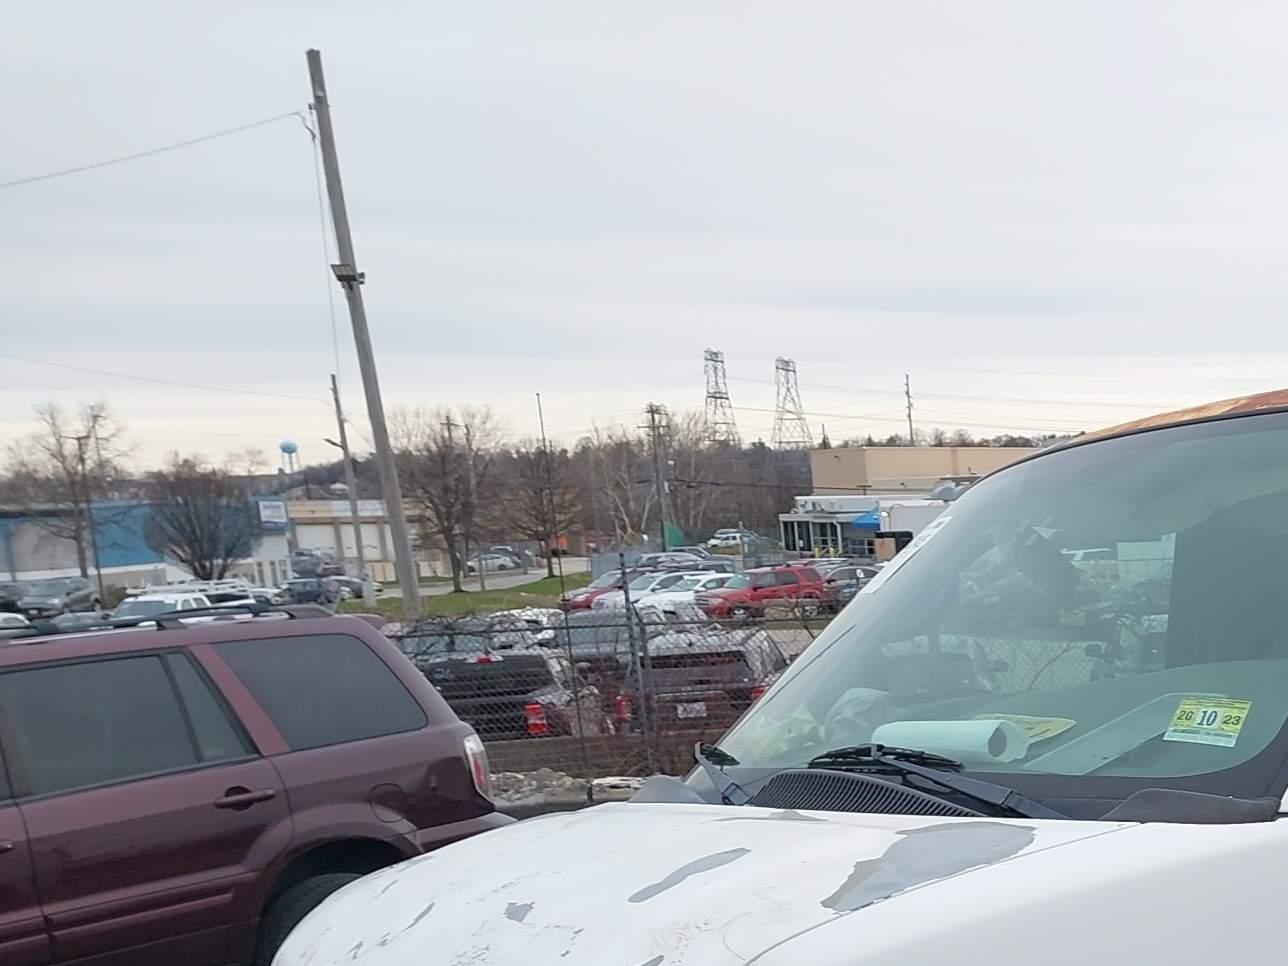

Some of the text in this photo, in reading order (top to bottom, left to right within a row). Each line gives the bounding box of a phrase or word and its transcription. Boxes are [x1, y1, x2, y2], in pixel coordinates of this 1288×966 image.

[1176, 710, 1241, 726] 20 10 23
